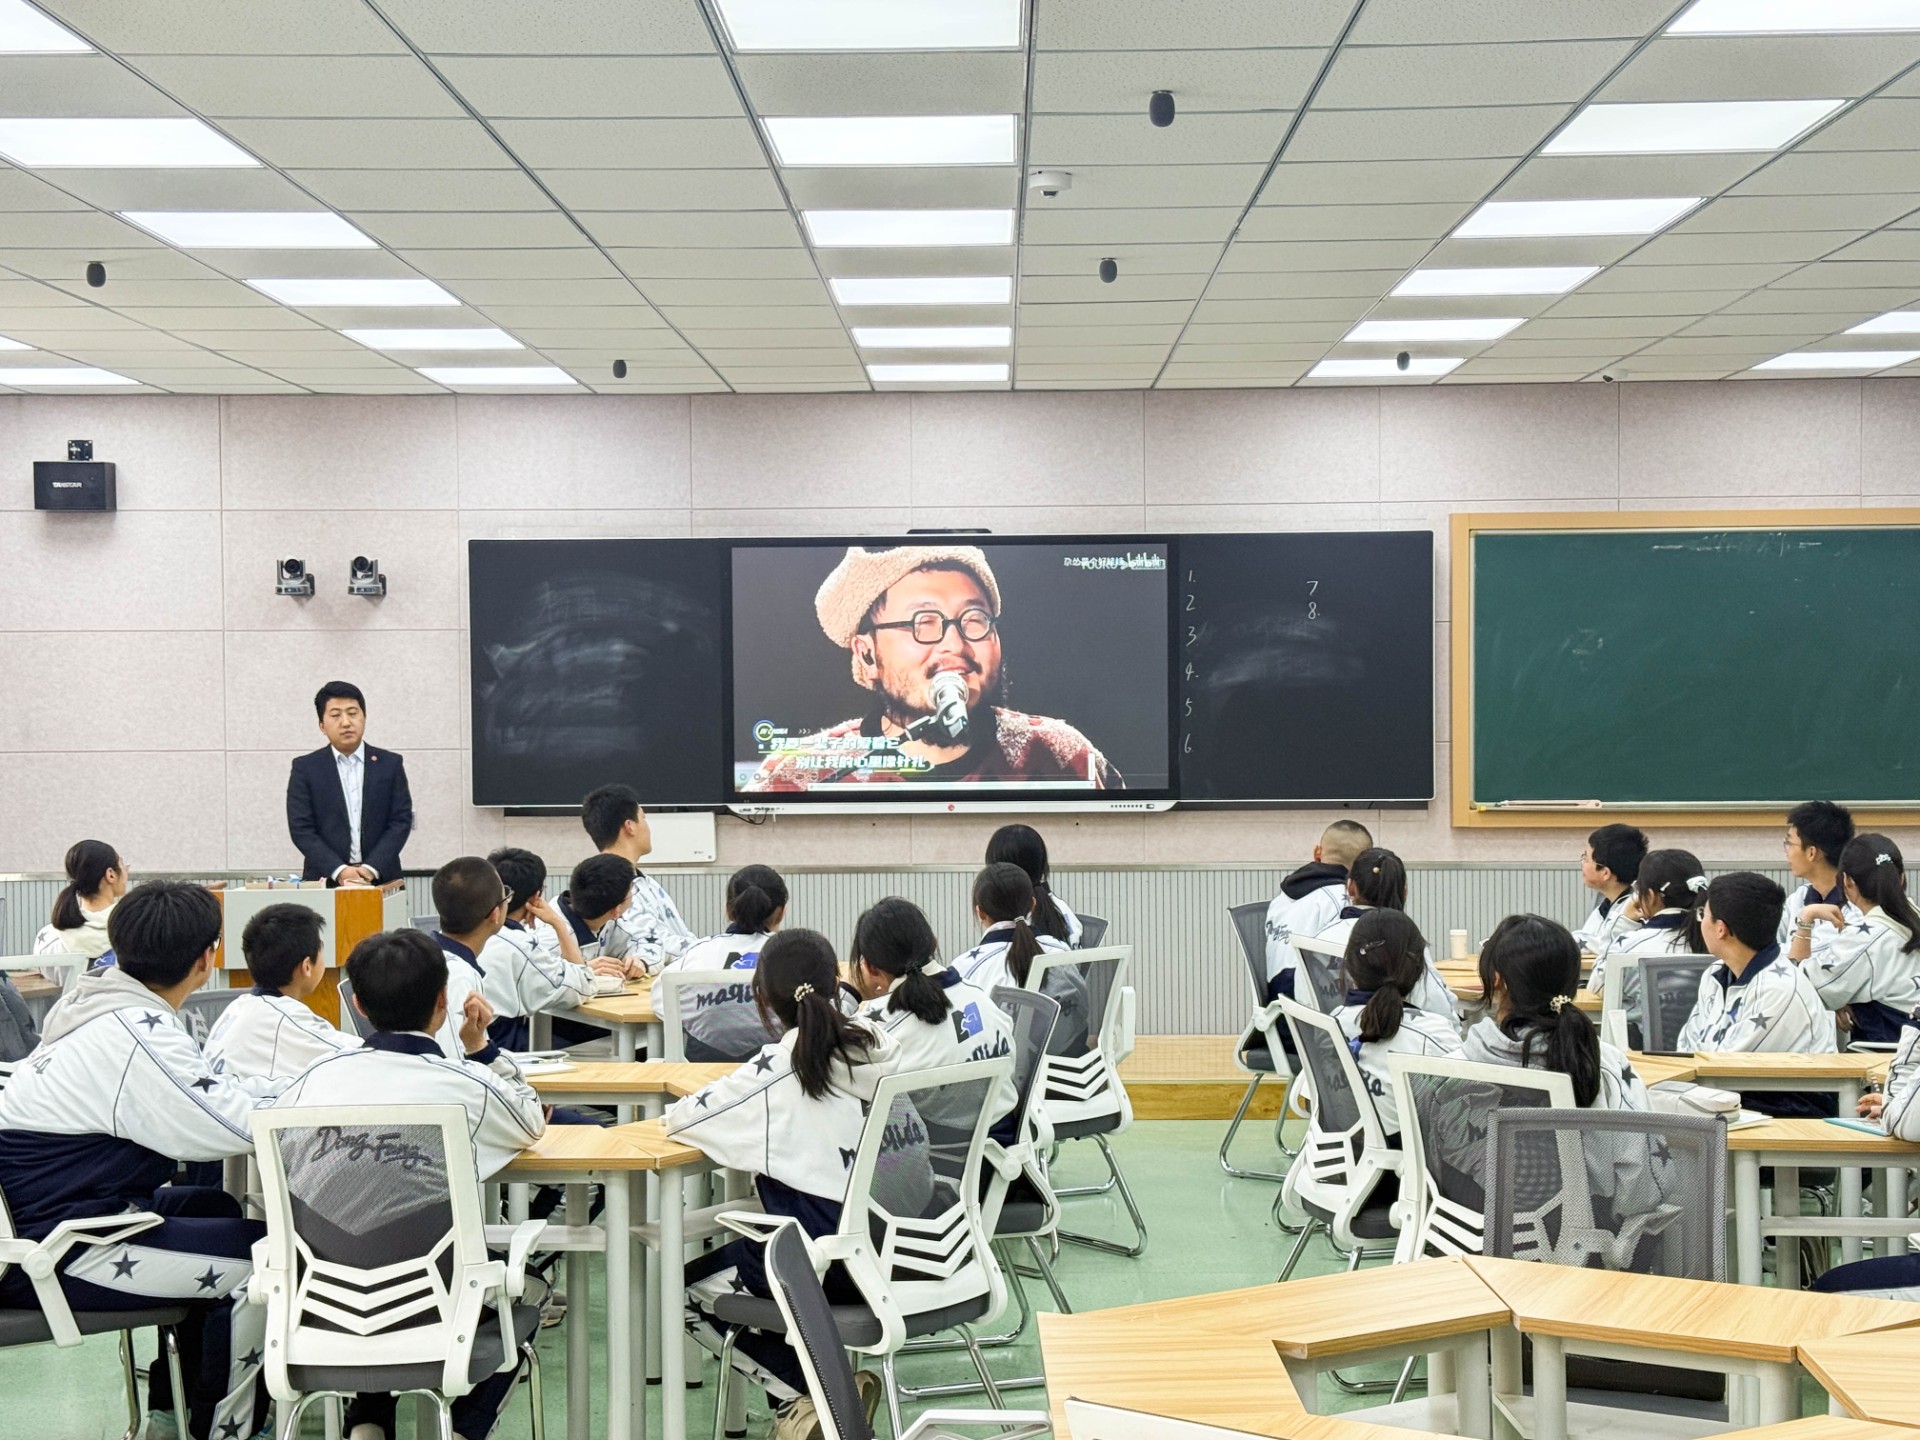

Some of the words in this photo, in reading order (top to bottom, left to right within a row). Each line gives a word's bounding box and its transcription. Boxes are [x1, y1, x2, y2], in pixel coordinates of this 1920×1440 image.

[1306, 580, 1319, 597] 7
[1185, 594, 1196, 612] 2
[1185, 625, 1197, 647] 3
[1184, 697, 1193, 717] 5
[1184, 732, 1193, 754] 6
